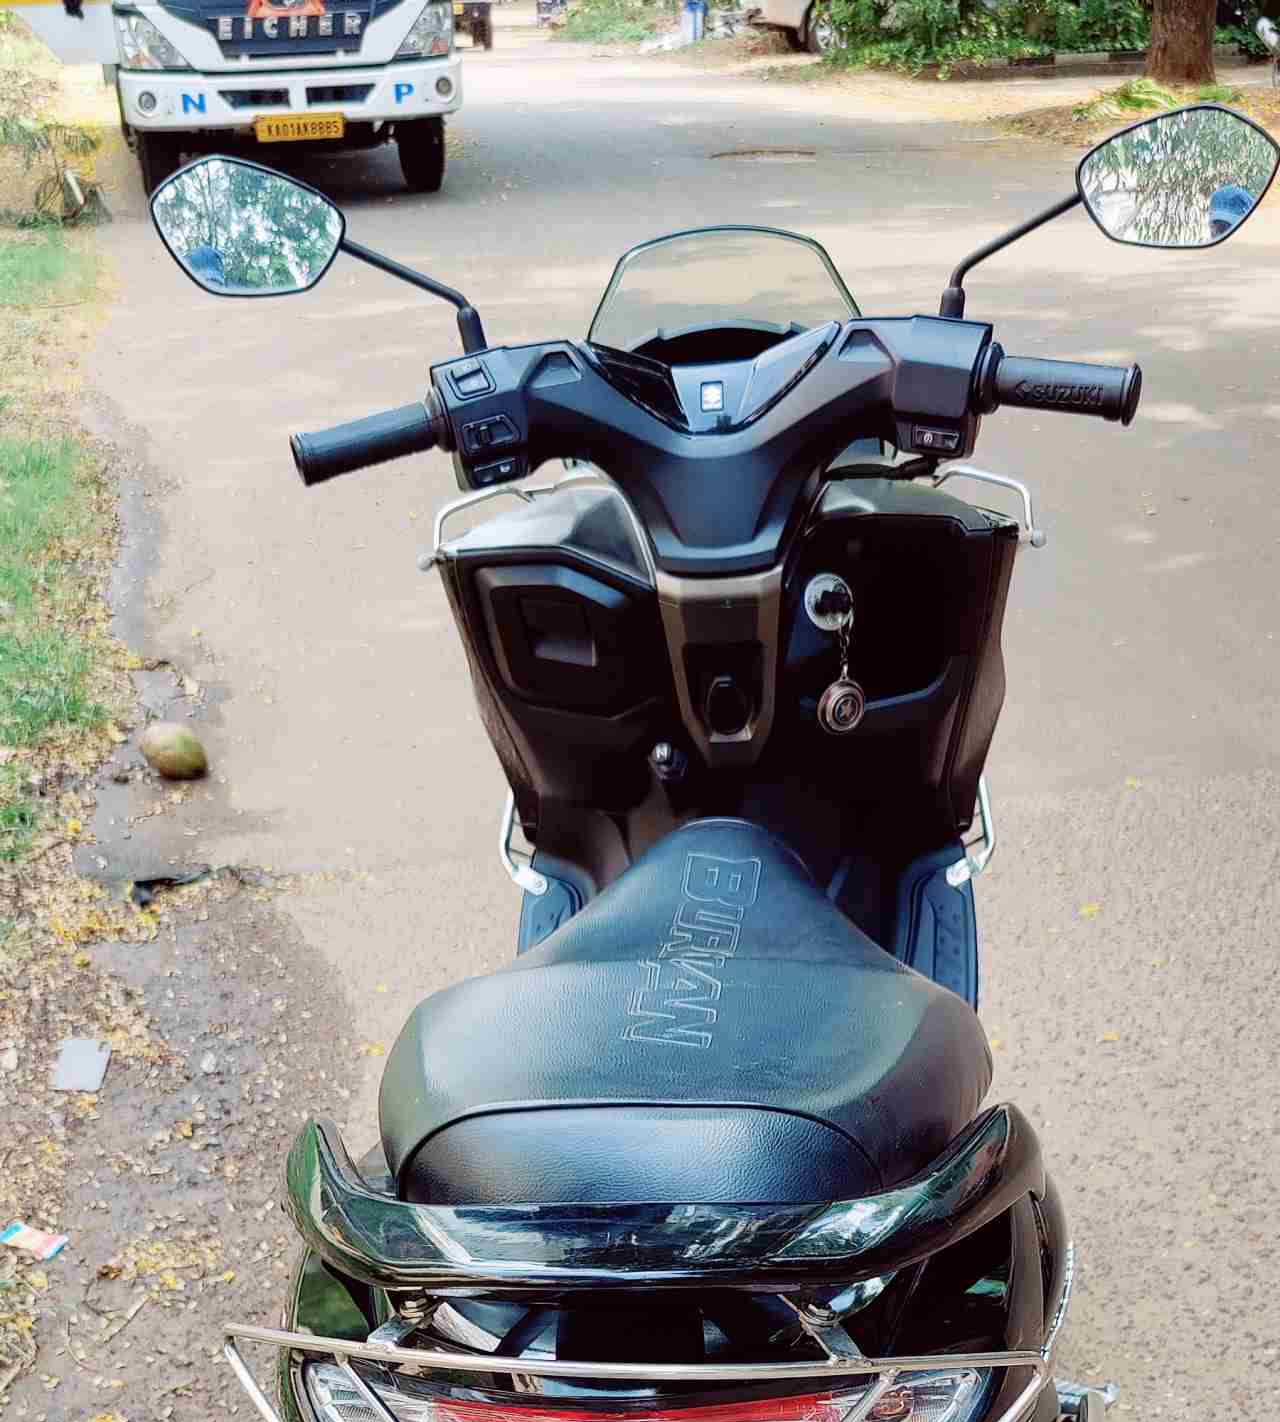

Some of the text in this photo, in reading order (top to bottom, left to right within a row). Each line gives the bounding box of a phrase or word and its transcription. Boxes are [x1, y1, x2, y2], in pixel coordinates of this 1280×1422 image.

[218, 12, 362, 40] EICHER
[181, 82, 414, 114] N P
[1031, 383, 1105, 406] SUZUKI
